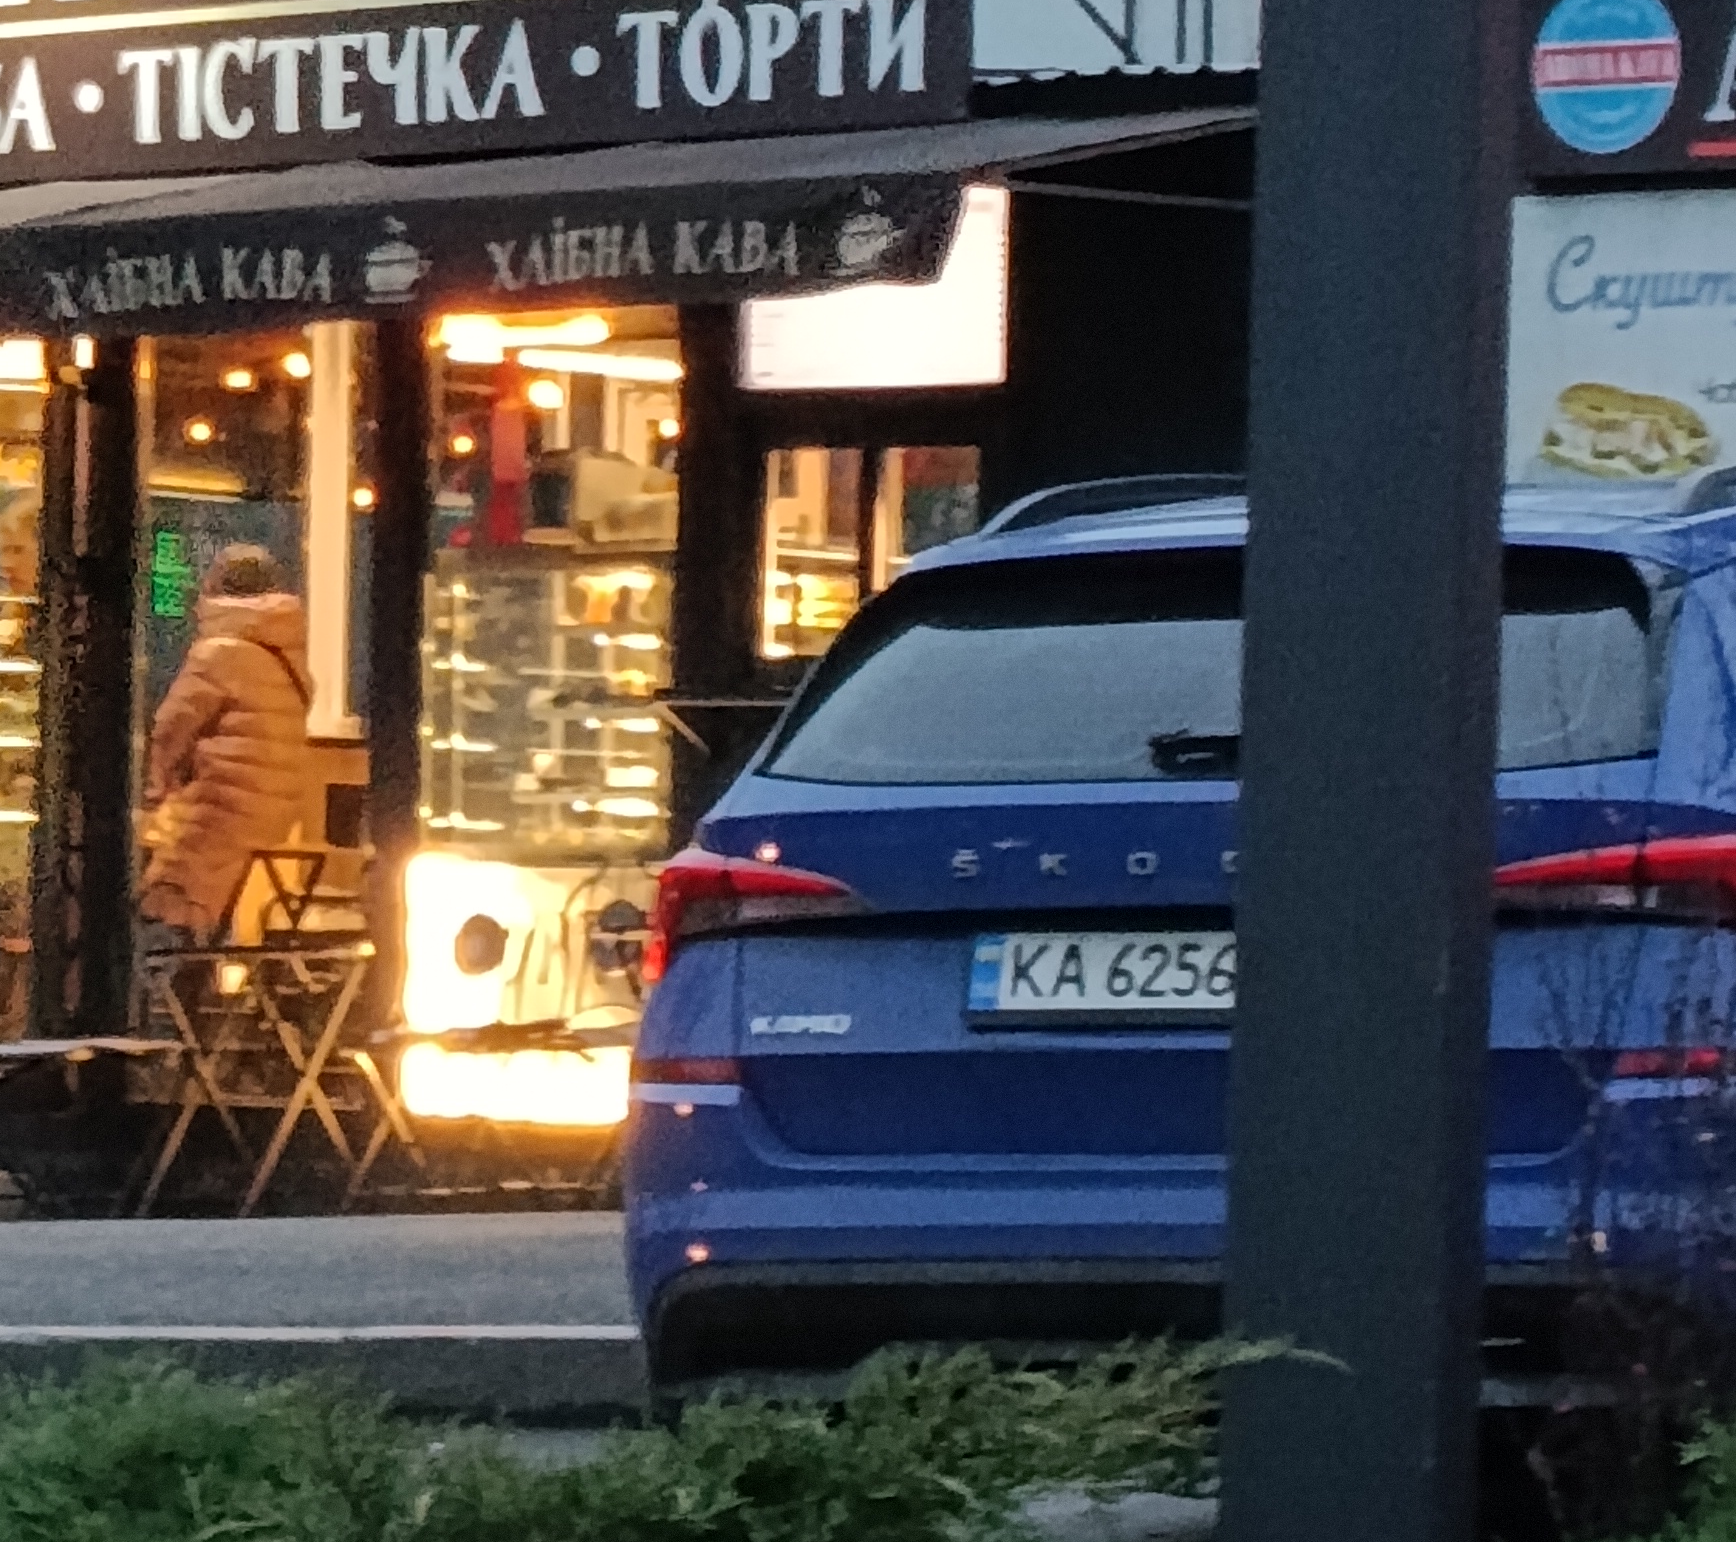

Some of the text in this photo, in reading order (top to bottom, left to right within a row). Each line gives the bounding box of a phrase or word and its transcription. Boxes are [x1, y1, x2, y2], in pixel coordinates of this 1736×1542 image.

[117, 18, 546, 146] ТІСТЕЧКА
[220, 244, 332, 305] КАВА
[673, 219, 800, 276] КАВА
[1106, 942, 1238, 998] 6256
